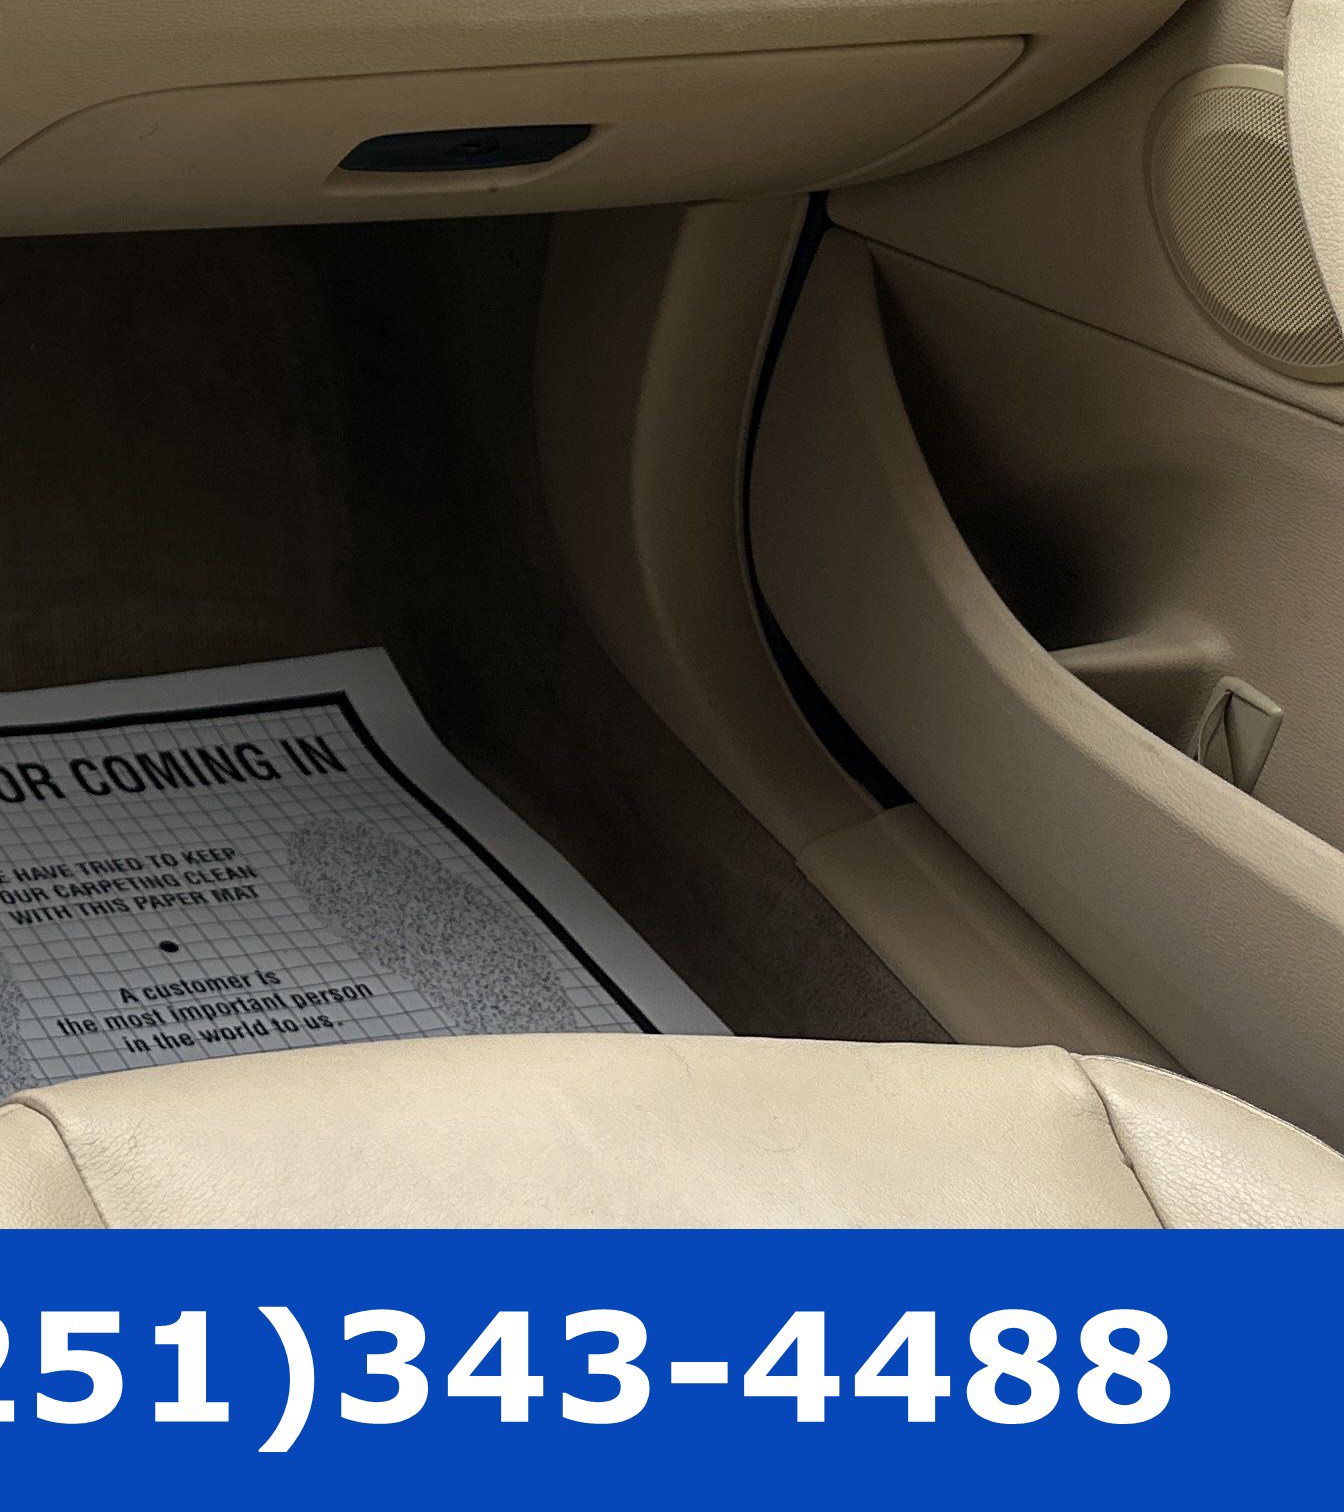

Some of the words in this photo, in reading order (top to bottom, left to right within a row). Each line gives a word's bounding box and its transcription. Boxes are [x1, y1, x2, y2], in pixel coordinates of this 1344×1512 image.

[70, 742, 280, 796] COMING
[278, 735, 347, 775] IN
[13, 863, 75, 882] HAVE
[76, 857, 144, 877] TRIED
[146, 853, 178, 869] TO
[181, 847, 237, 865] KEEP
[53, 873, 180, 899] CARPETING
[183, 865, 258, 886] CLEAN
[9, 905, 73, 926] WITH
[74, 898, 130, 917] THIS
[133, 891, 210, 911] PAPER
[211, 884, 260, 904] MAT
[119, 987, 139, 1004] A
[145, 975, 252, 1001] customer
[255, 969, 282, 987] is
[56, 1018, 99, 1038] the
[103, 1008, 165, 1030] most
[169, 993, 288, 1025] important
[290, 982, 374, 1010] person
[122, 1036, 151, 1054] in
[153, 1029, 195, 1049] the
[198, 1018, 268, 1042] world
[271, 1016, 300, 1034] to
[302, 1013, 343, 1029] us.
